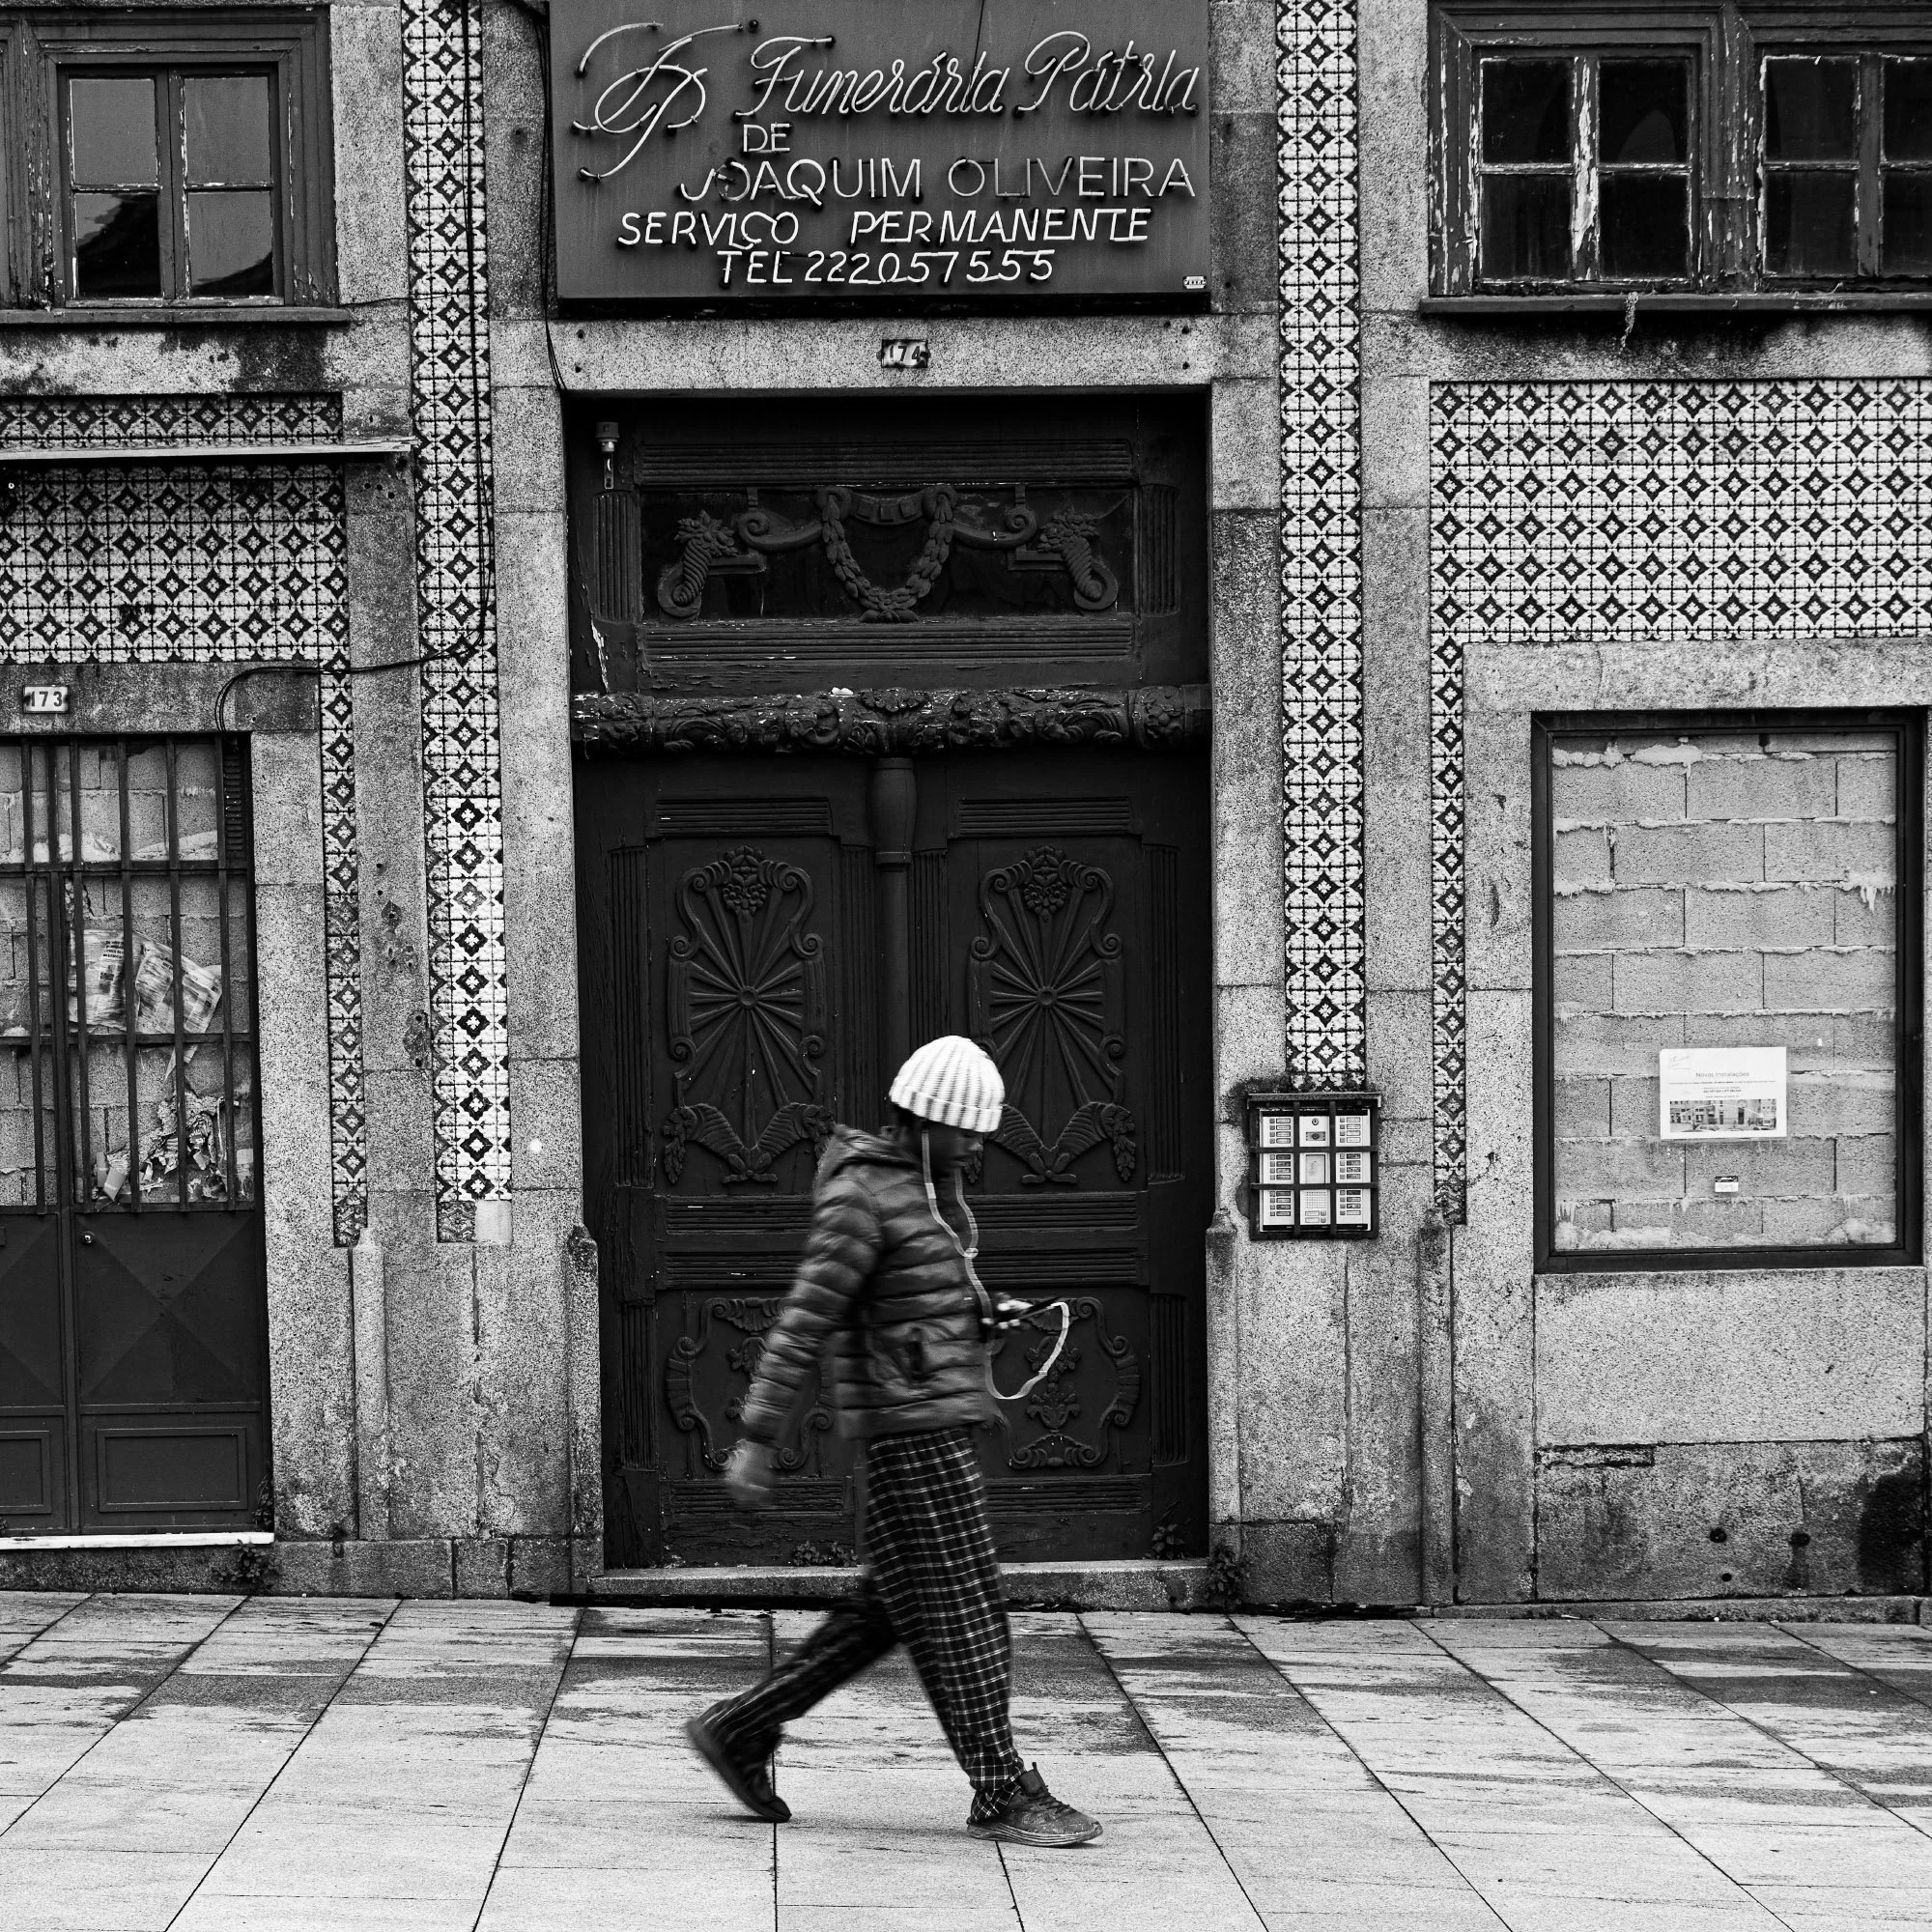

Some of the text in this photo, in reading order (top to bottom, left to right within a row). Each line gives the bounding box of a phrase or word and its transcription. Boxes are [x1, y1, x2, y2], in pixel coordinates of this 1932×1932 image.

[734, 30, 1200, 115] Funerária Pátria
[743, 123, 790, 153] DE
[680, 156, 1196, 206] JOAQUIM OLIVEIRA
[617, 208, 1151, 250] SERVIÇO PERMANENTE
[717, 248, 1056, 285] TEL 222057555
[889, 345, 923, 364] 174
[31, 691, 63, 707] 173
